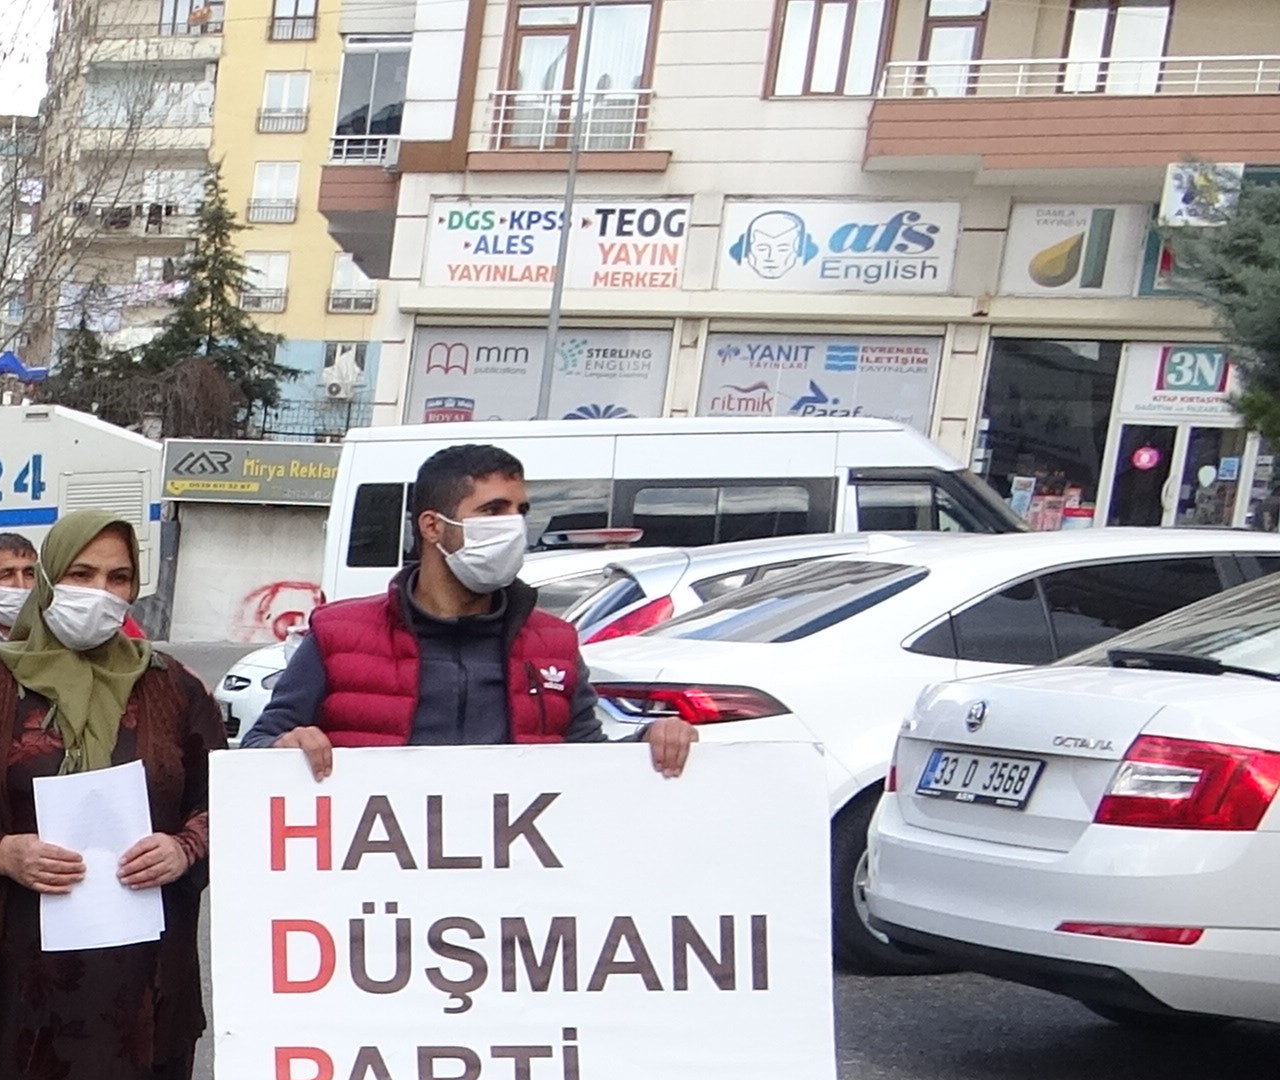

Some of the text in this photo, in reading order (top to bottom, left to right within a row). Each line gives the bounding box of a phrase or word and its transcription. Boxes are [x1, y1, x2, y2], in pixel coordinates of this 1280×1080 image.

[446, 210, 495, 231] DGS
[595, 208, 688, 238] TEOG
[828, 210, 941, 254] afs
[473, 234, 535, 255] ALES
[598, 242, 678, 266] YAYIN
[593, 267, 679, 288] MERKEZİ
[819, 260, 939, 284] English
[475, 345, 529, 363] mm
[586, 348, 653, 360] STERLING
[746, 343, 816, 362] YANIT
[860, 345, 929, 355] EVRENSEL
[585, 360, 652, 371] ENGLISH
[748, 361, 808, 370] YAYINLARI
[858, 364, 928, 374] YAYINLARI
[1167, 351, 1223, 387] 3N
[710, 391, 774, 412] ritmik
[801, 404, 864, 417] Paraf
[242, 459, 285, 481] Mirya
[1052, 736, 1115, 752] OCTAVIA
[933, 755, 1031, 795] 33 D 3568
[269, 791, 564, 872] HALK
[271, 901, 771, 1015] DÜŞMANI
